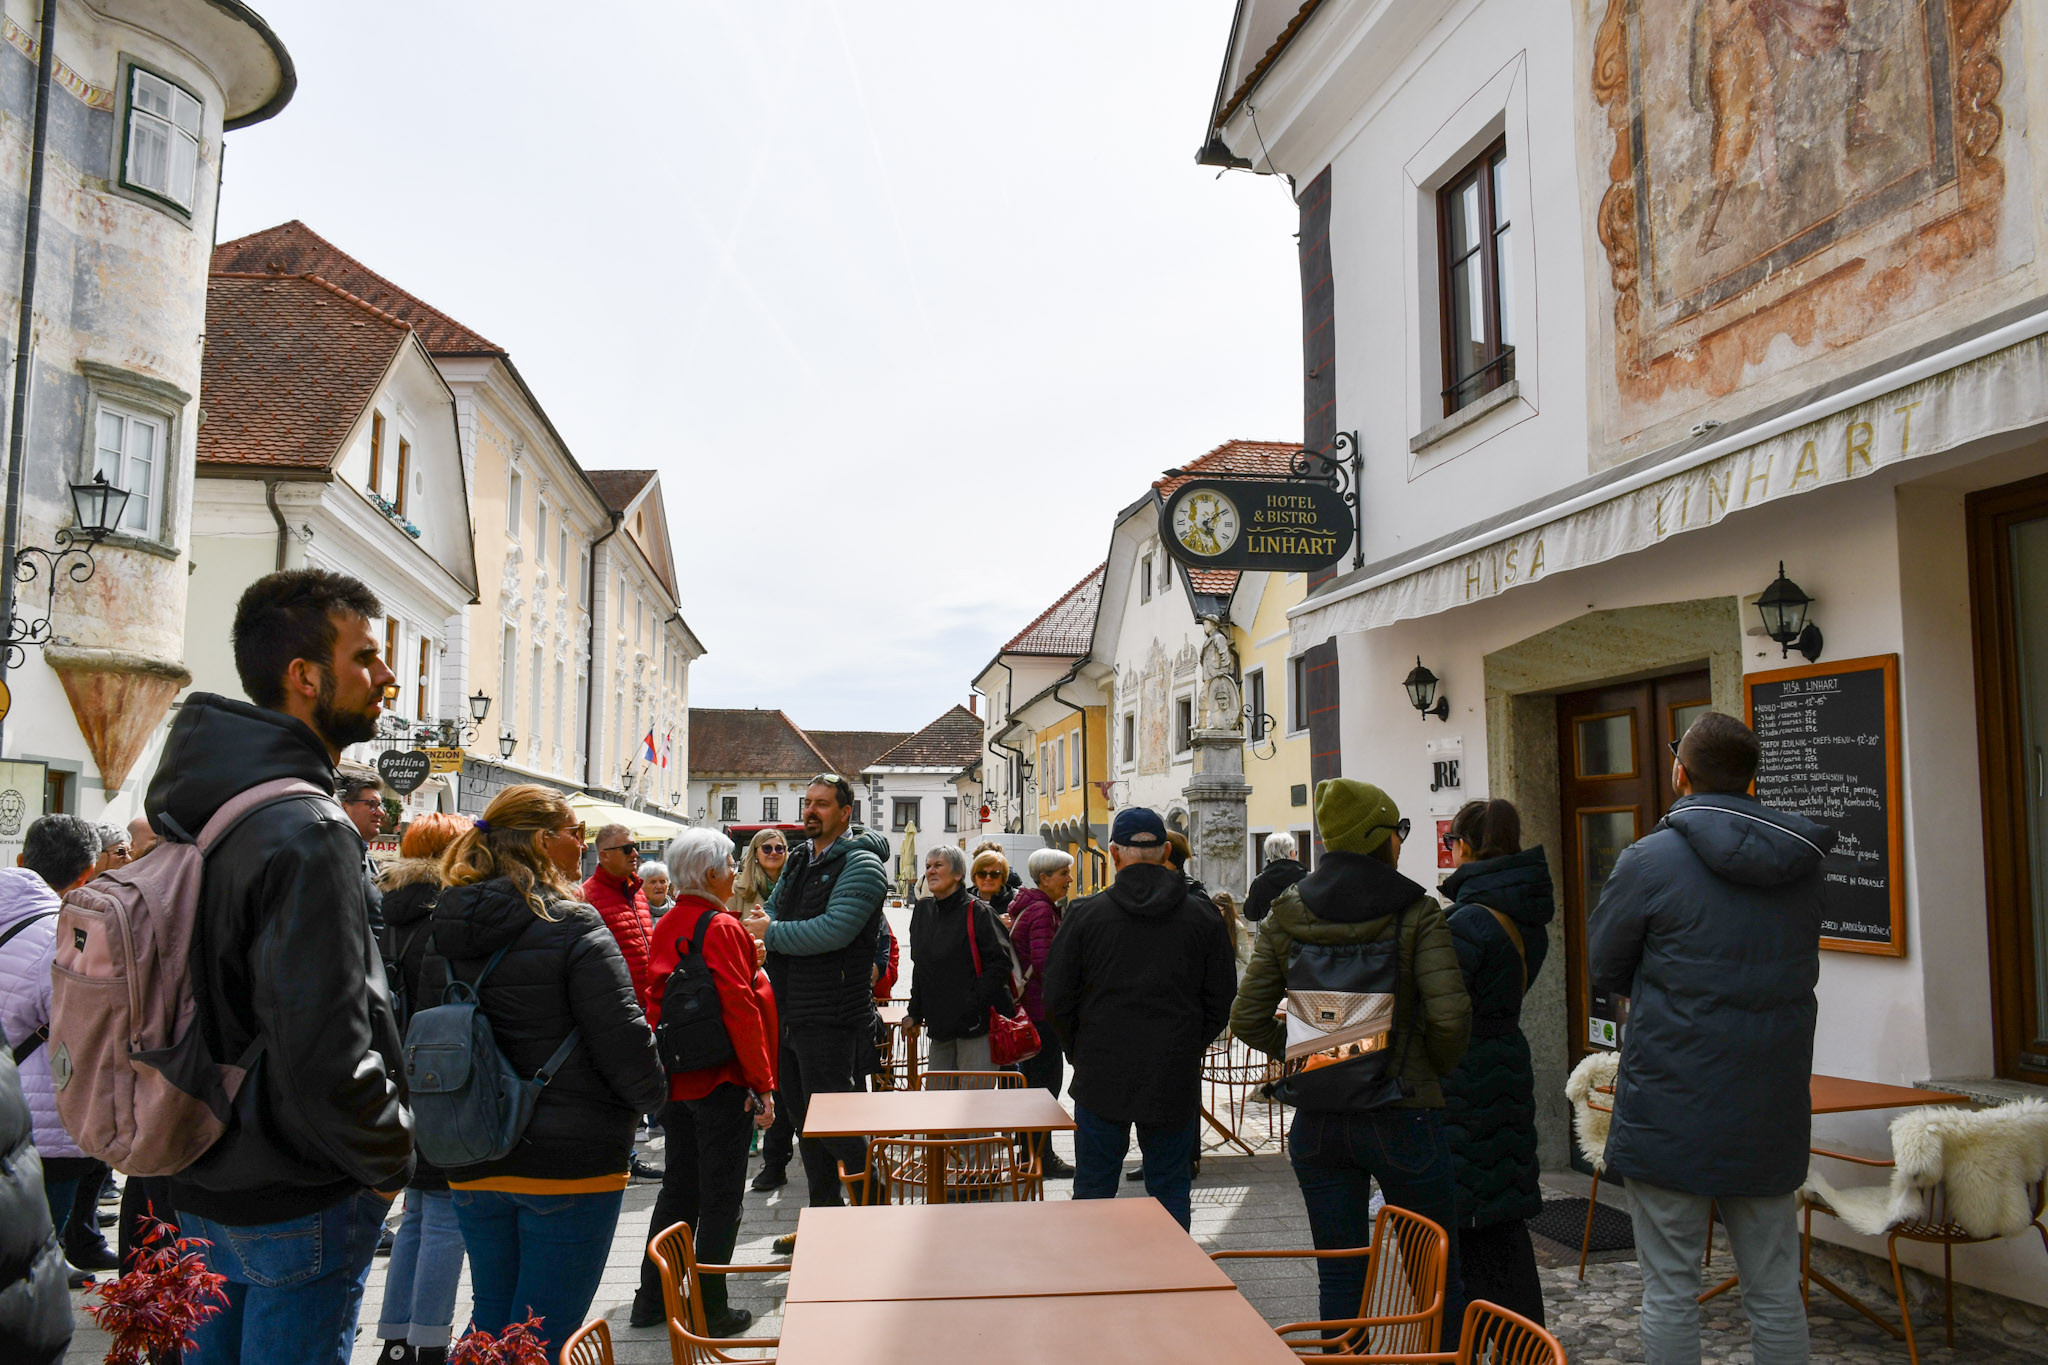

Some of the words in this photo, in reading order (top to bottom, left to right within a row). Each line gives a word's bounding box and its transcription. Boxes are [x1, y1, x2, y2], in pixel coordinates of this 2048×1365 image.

[1266, 495, 1316, 509] HOTEL
[1465, 539, 1545, 599] HIŠA
[1656, 401, 1923, 537] LINHART
[1254, 510, 1264, 522] &
[1267, 510, 1318, 524] BISTRO
[1247, 536, 1337, 556] LINHART
[1783, 681, 1800, 694] HIŠA
[1806, 678, 1838, 692] LINHART
[382, 758, 425, 768] gostilna
[388, 769, 419, 778] lectar
[1430, 760, 1460, 792] JRE
